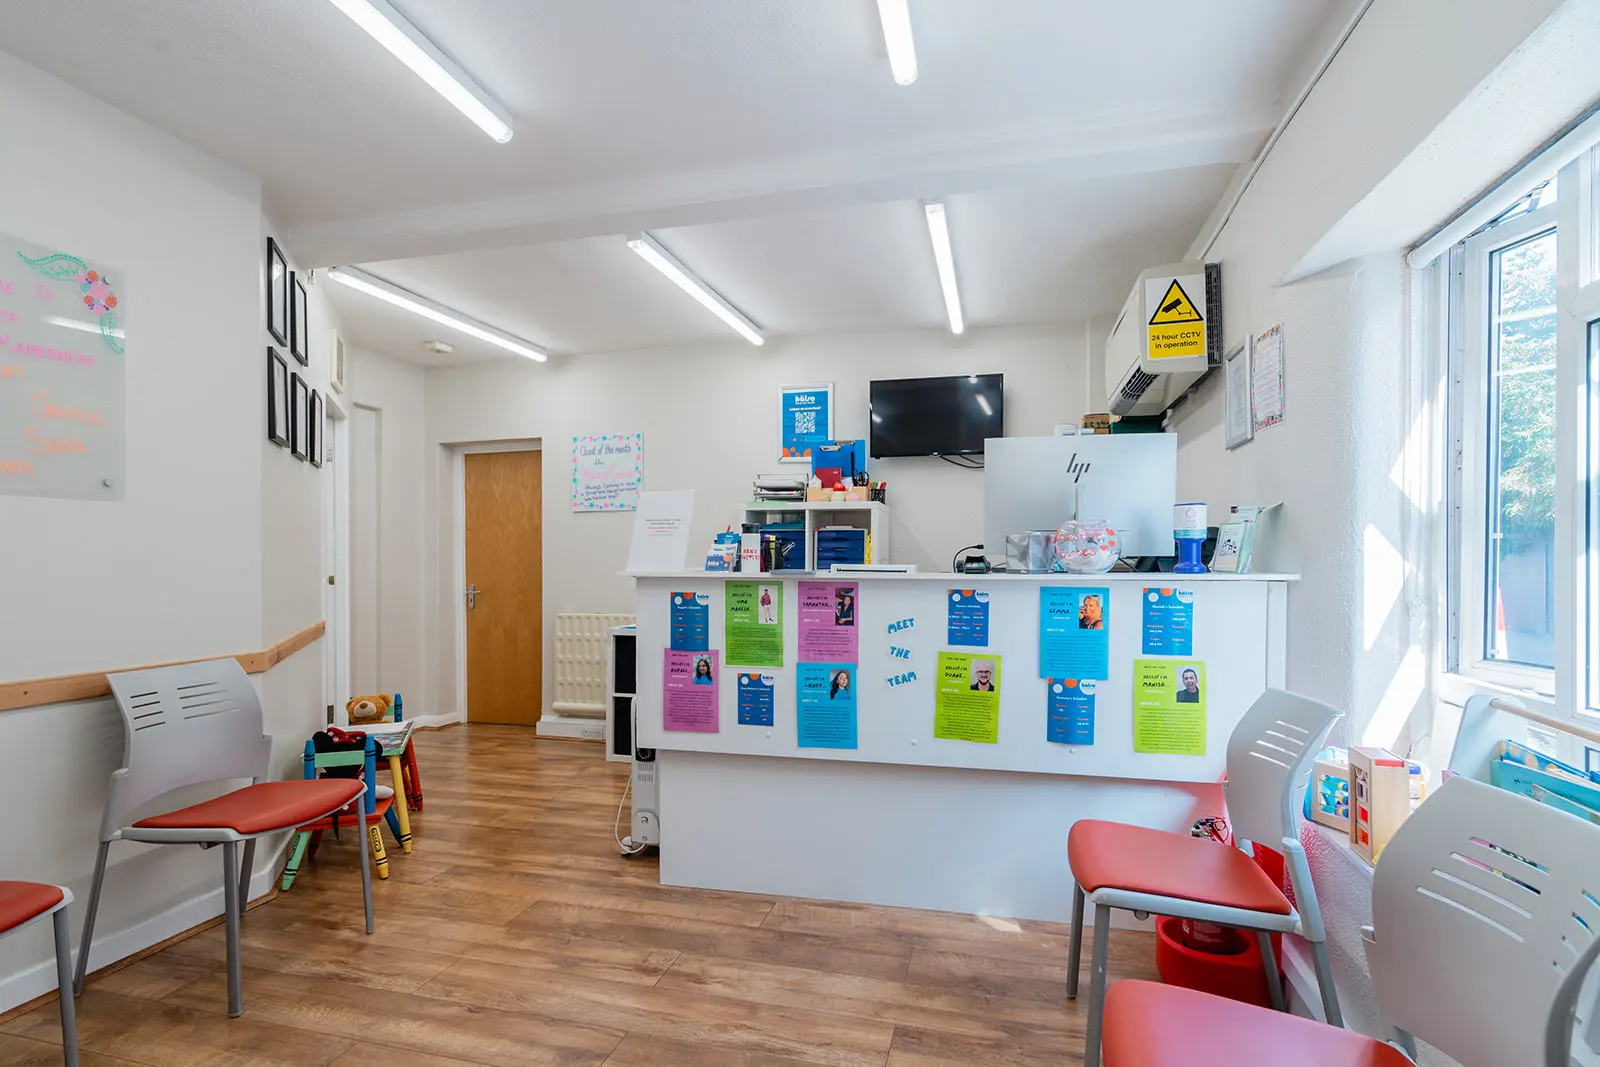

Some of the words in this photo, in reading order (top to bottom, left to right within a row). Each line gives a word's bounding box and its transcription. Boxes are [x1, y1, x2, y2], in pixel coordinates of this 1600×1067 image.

[1180, 331, 1201, 339] CCTV
[1163, 340, 1198, 349] operation
[1066, 453, 1091, 484] hp
[888, 618, 915, 635] MEET
[890, 646, 911, 660] THE
[887, 671, 917, 687] TEAM
